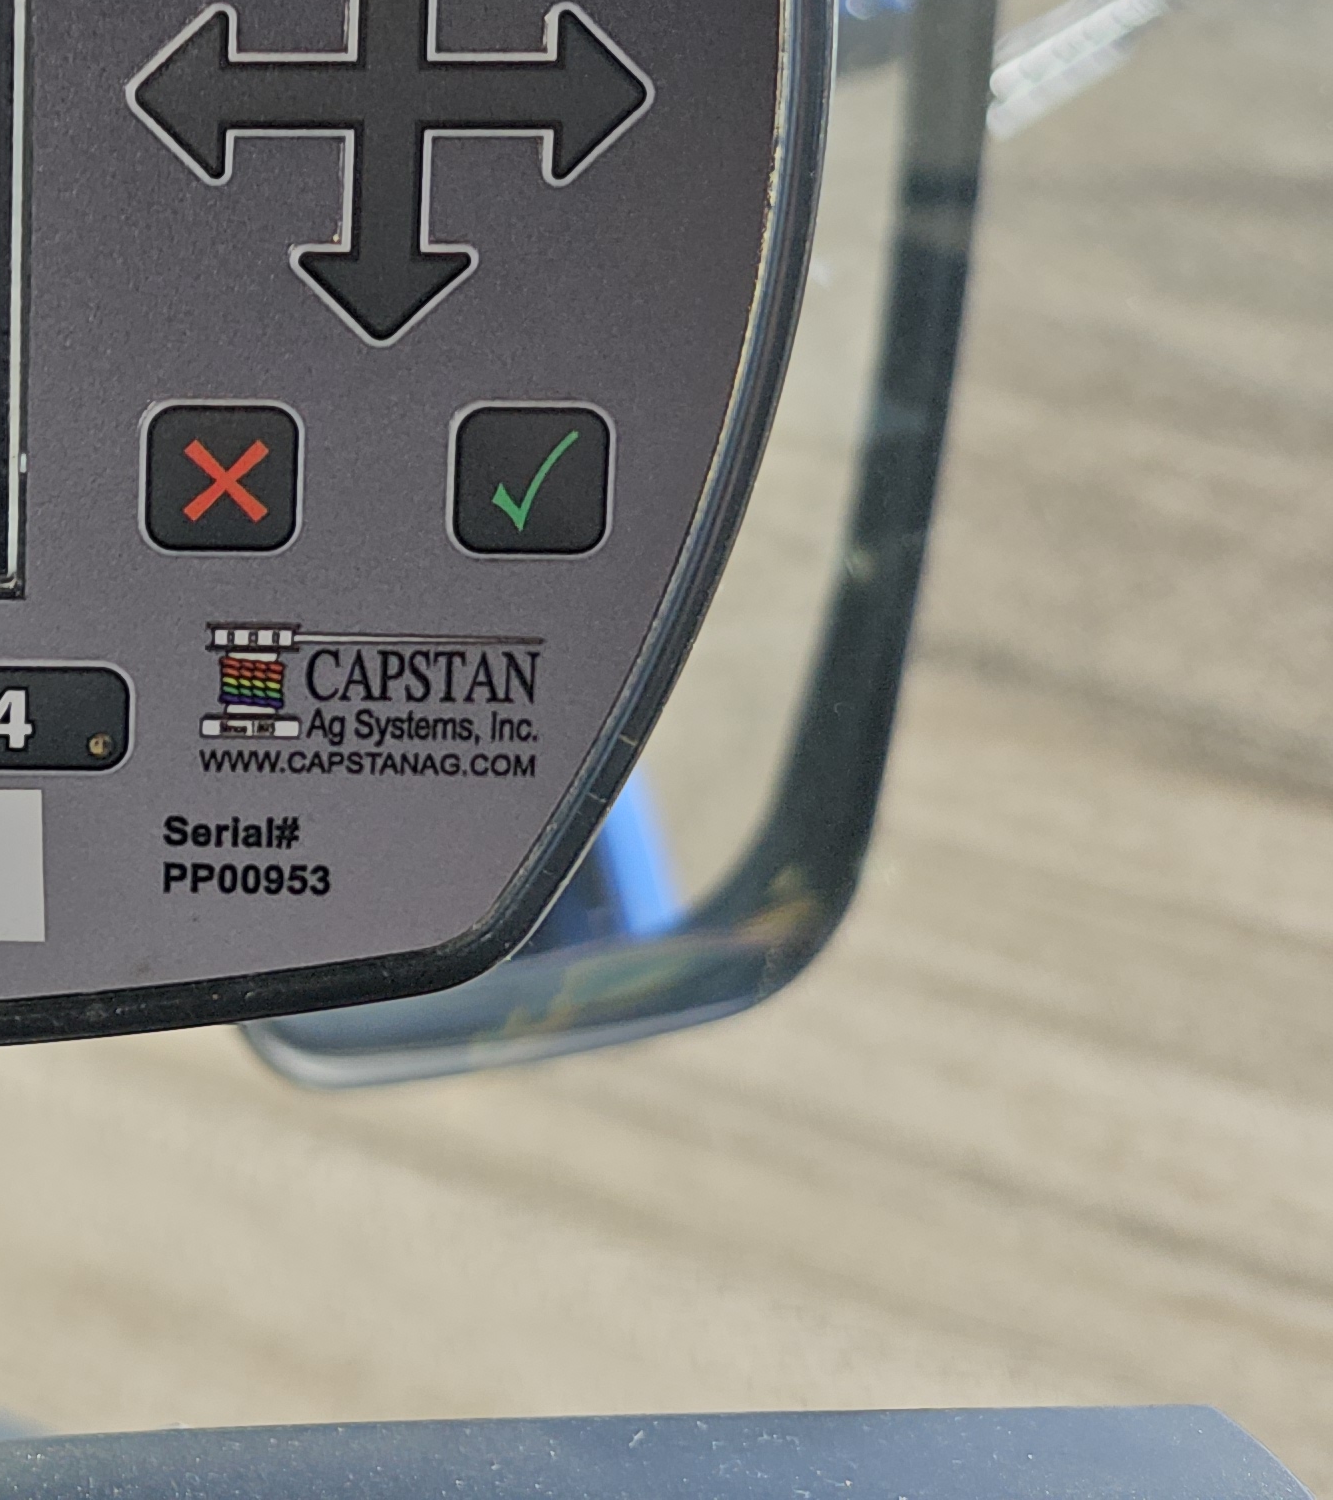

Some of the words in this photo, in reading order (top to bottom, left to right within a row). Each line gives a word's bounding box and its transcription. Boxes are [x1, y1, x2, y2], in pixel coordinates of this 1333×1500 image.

[305, 648, 541, 705] CAPSTAN
[305, 707, 346, 748] Ag
[353, 708, 482, 748] Systems,
[489, 710, 539, 743] Inc.
[198, 748, 537, 777] WWW.CAPSTANAG.COM
[162, 814, 301, 850] Serial#
[162, 861, 332, 898] PP00953
